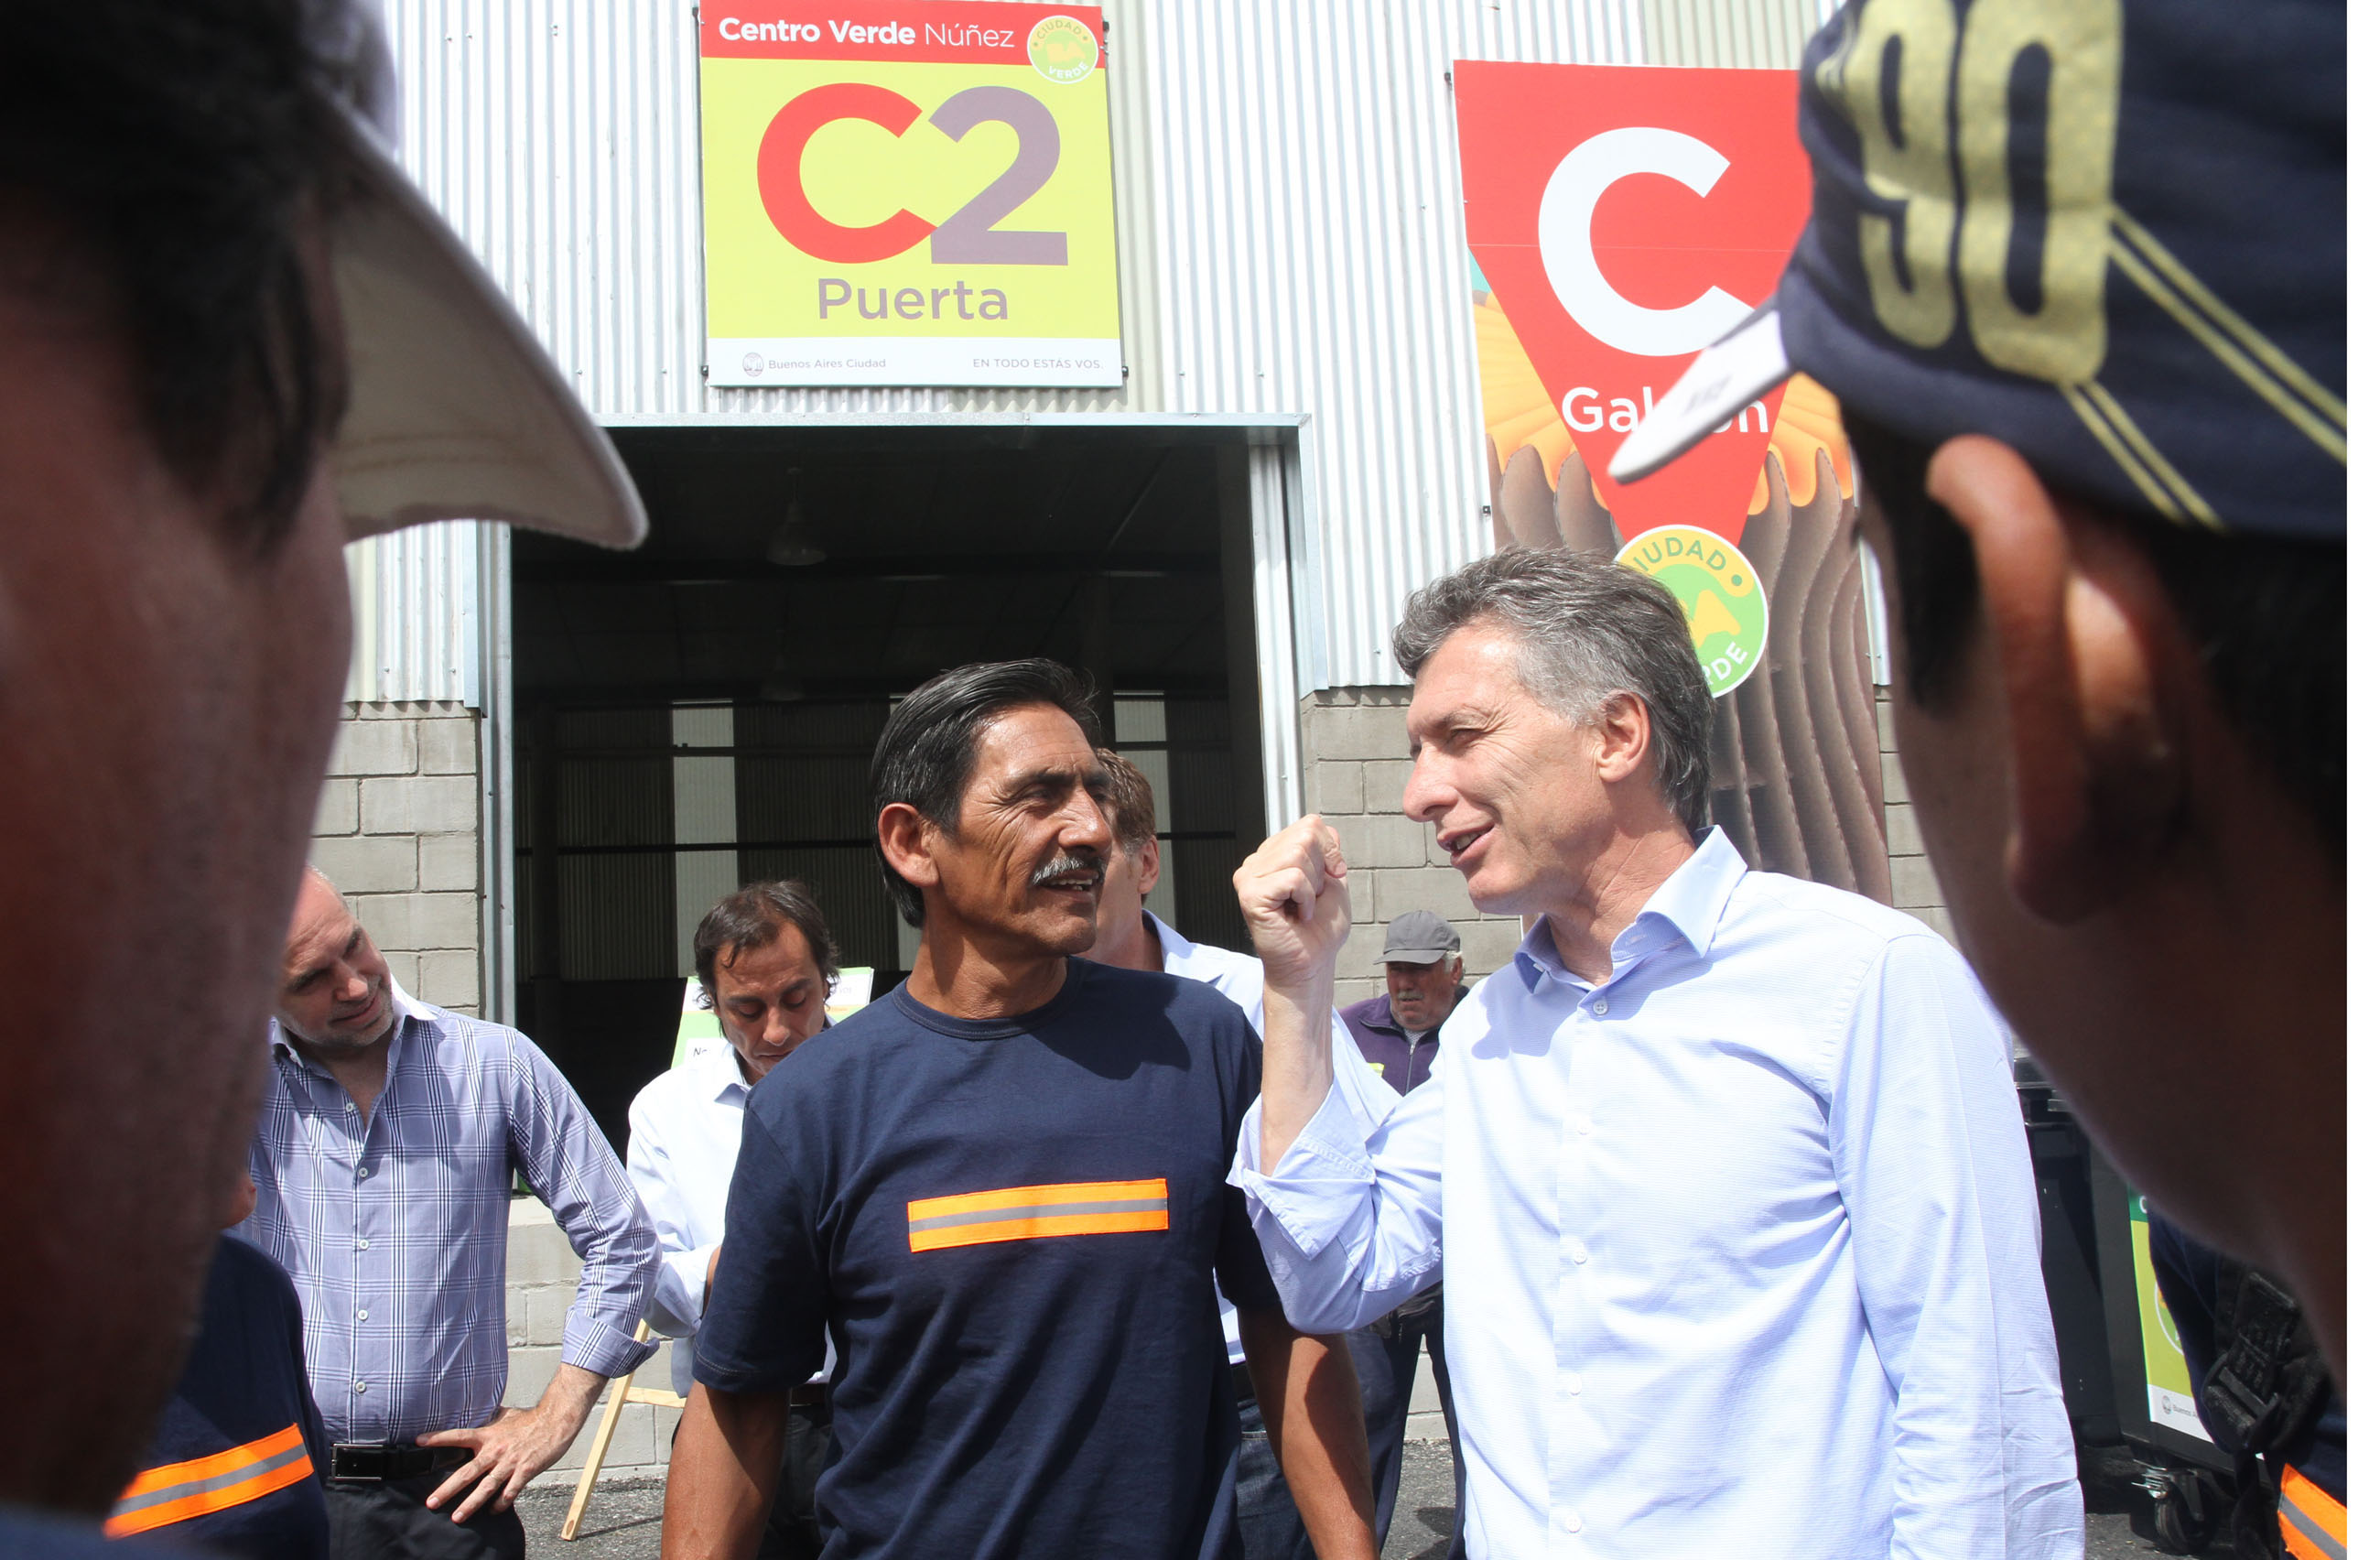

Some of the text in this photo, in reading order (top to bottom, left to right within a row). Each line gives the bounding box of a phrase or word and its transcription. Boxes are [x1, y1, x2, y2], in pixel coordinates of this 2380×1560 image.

[719, 16, 1015, 48] Centro Verde Núñez
[1036, 20, 1082, 39] CIUDAD
[1048, 61, 1088, 79] VERDE
[757, 82, 1069, 265] C2
[1538, 126, 1757, 357] C
[818, 277, 1009, 320] Puerta
[768, 358, 887, 370] Buenos Aires Ciudad
[972, 358, 990, 368] EN
[993, 358, 1030, 369] TODO
[1562, 385, 1769, 433] Galn
[1632, 536, 1727, 572] IUDAD
